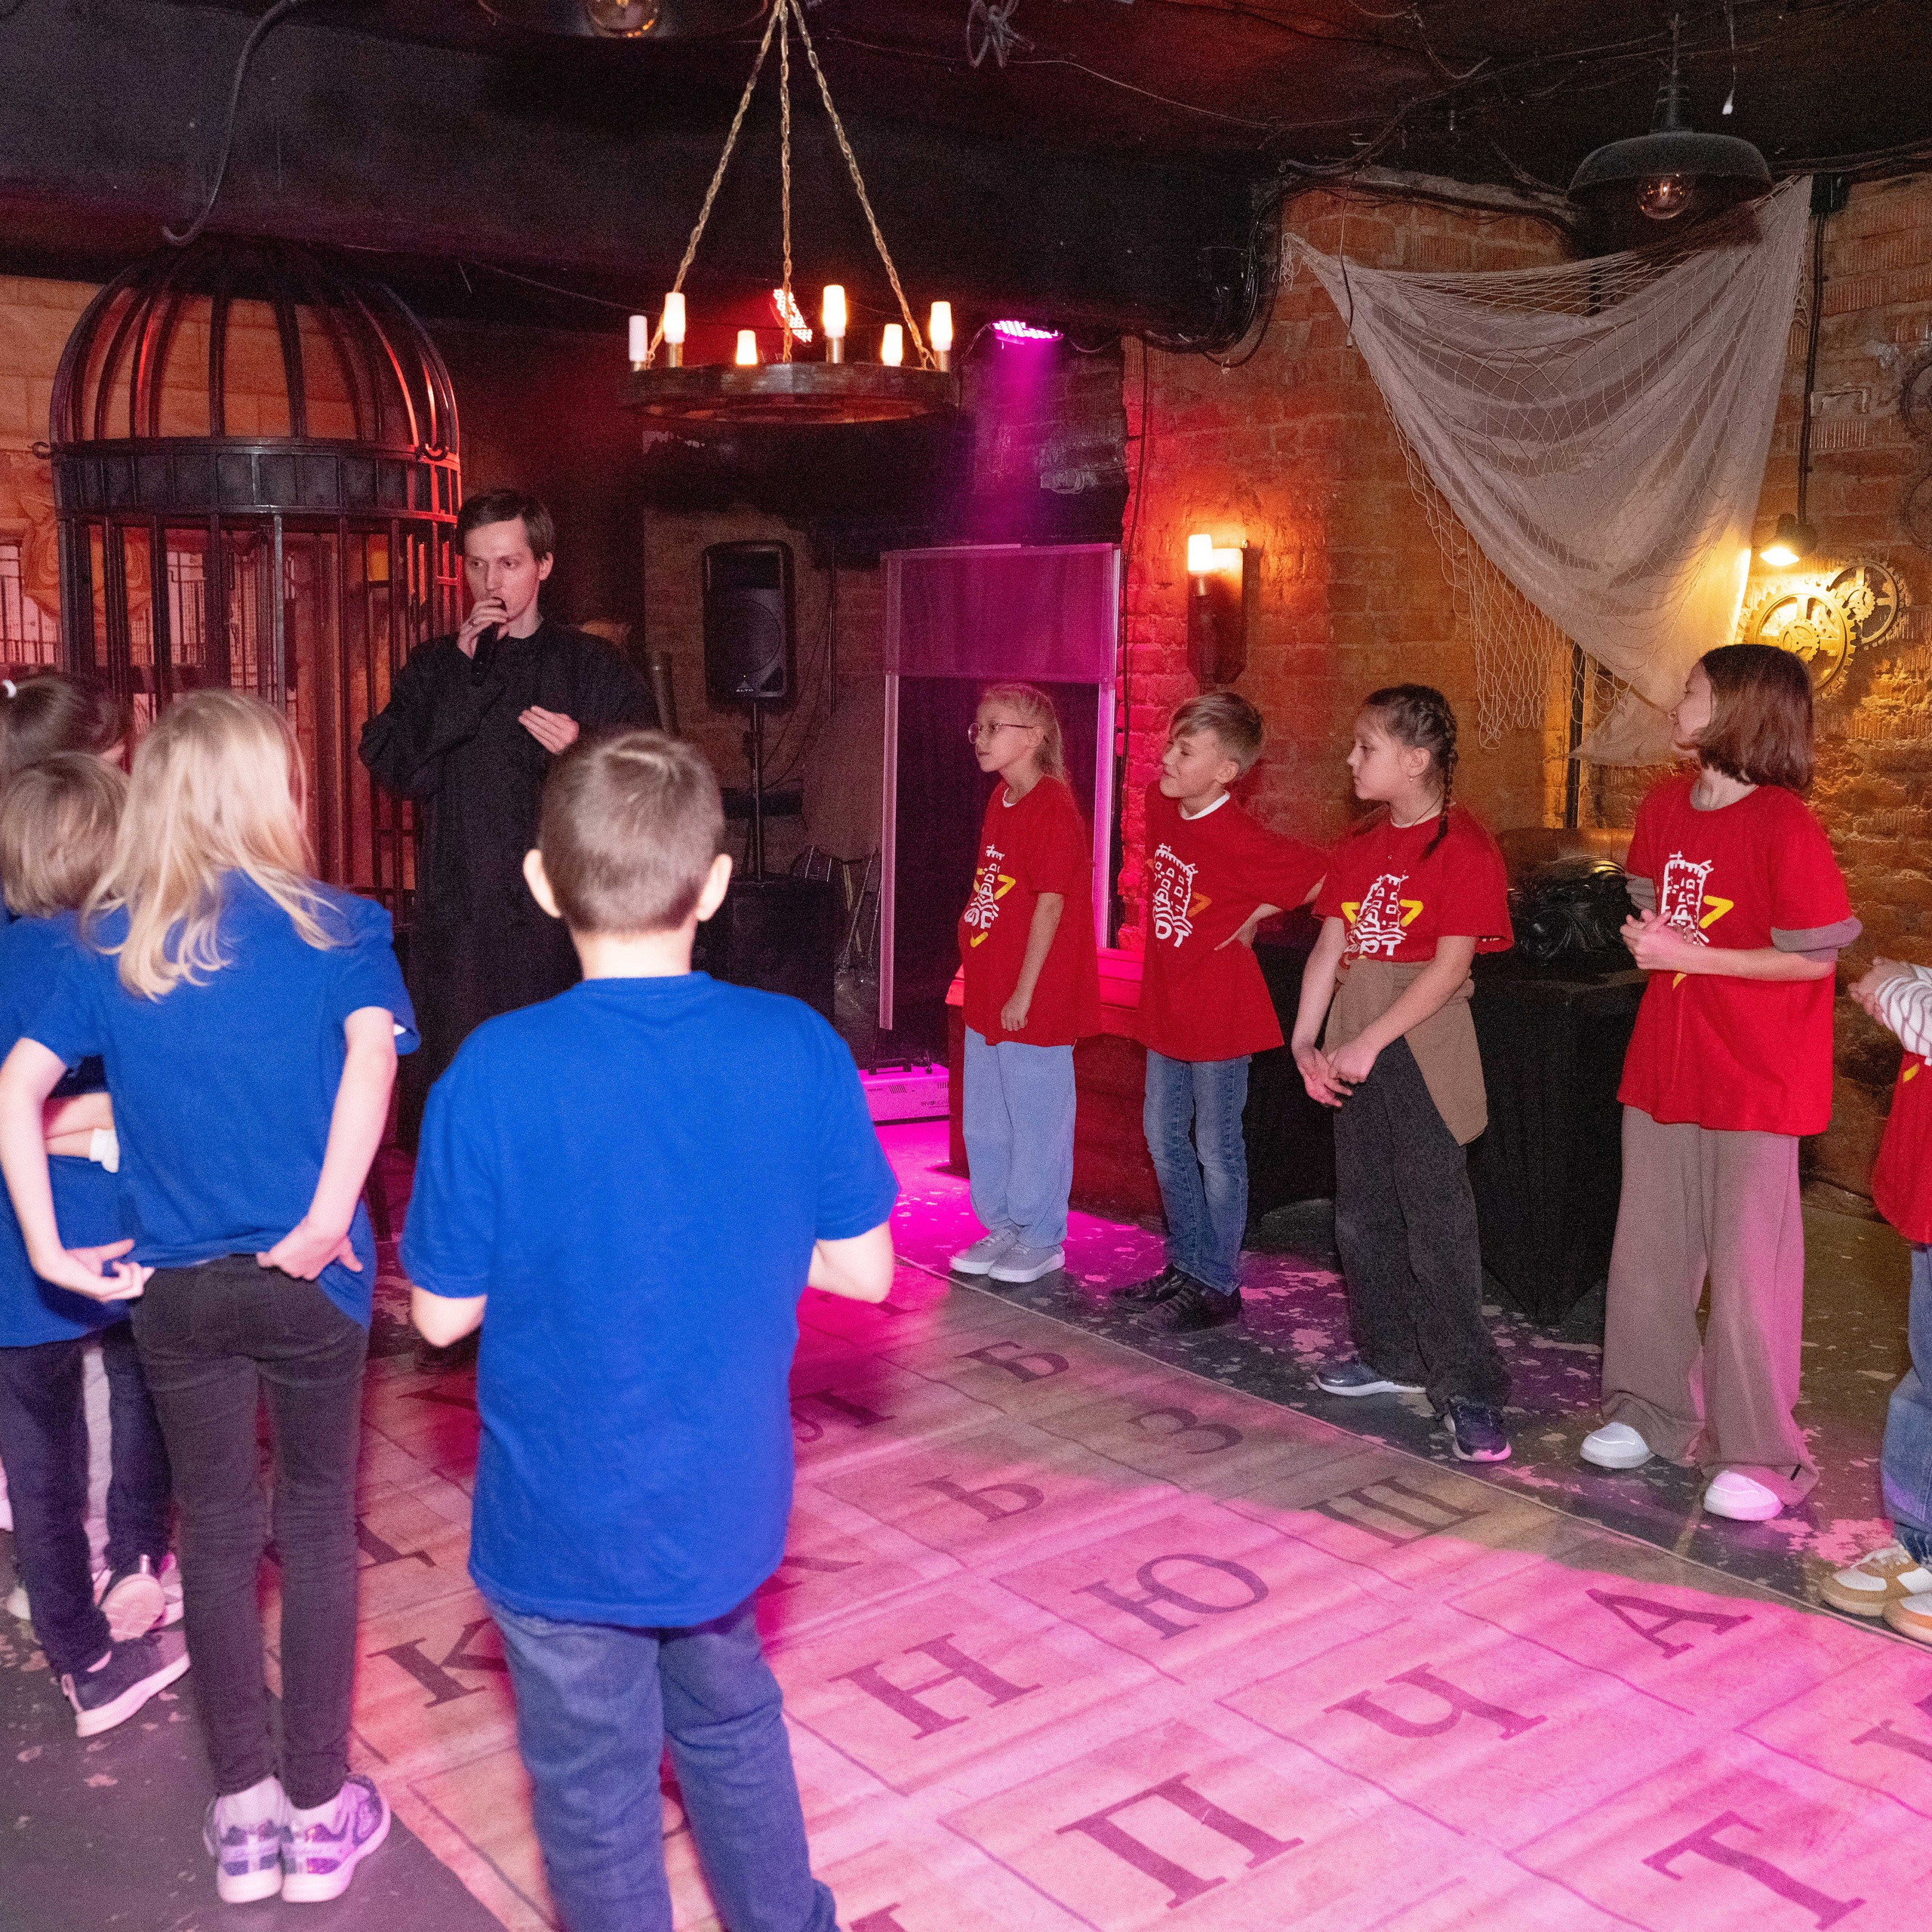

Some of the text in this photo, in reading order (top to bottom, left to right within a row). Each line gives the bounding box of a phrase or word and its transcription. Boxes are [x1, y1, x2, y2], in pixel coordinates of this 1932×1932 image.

[954, 1340, 1069, 1383] Б
[1300, 1475, 1492, 1549] Ш
[1072, 1552, 1269, 1641] Ю
[1585, 1587, 1755, 1659] А
[828, 1632, 1043, 1740] Н
[1324, 1662, 1548, 1741] Ч
[1056, 1772, 1304, 1909] П
[1642, 1810, 1866, 1930] Т
